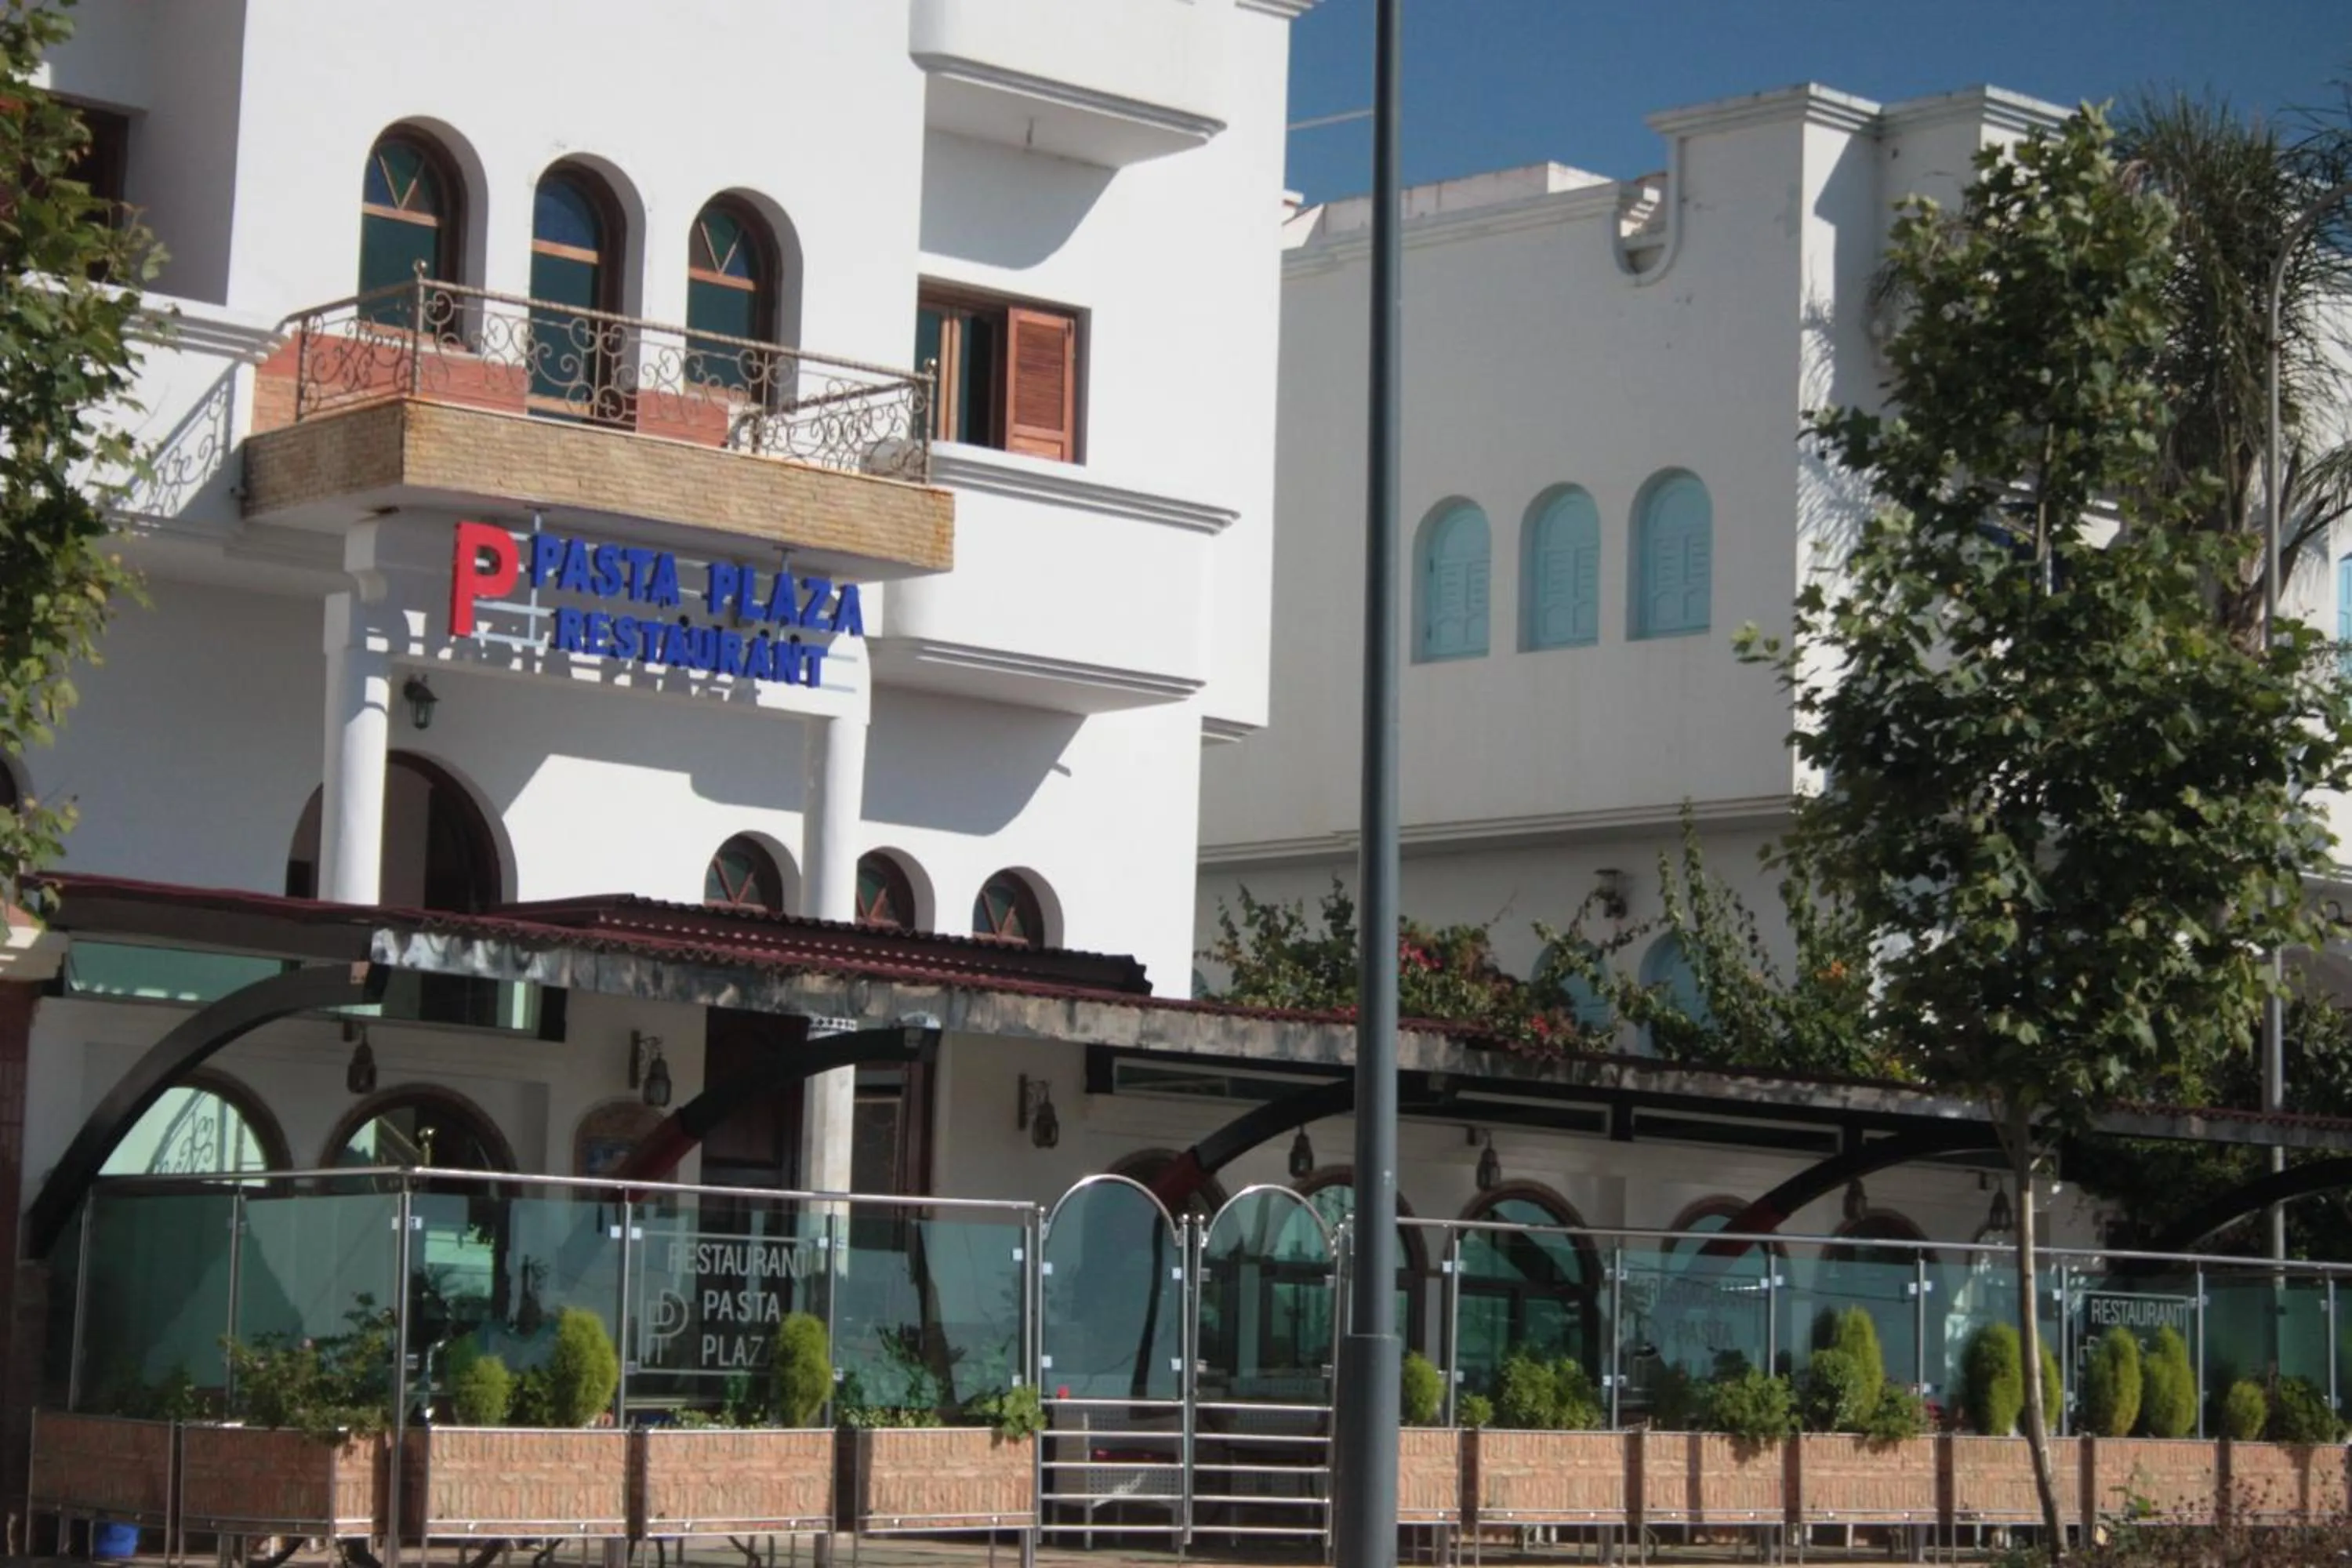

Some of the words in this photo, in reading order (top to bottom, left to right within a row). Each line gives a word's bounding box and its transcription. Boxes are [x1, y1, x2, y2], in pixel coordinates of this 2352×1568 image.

[449, 521, 520, 637] P
[531, 532, 681, 608] PASTA
[707, 559, 863, 637] PLAZA
[554, 607, 829, 688] RESTAURANT
[702, 1290, 781, 1323] PASTA
[2090, 1298, 2185, 1328] RESTAURANT
[701, 1333, 770, 1368] PLAZ
